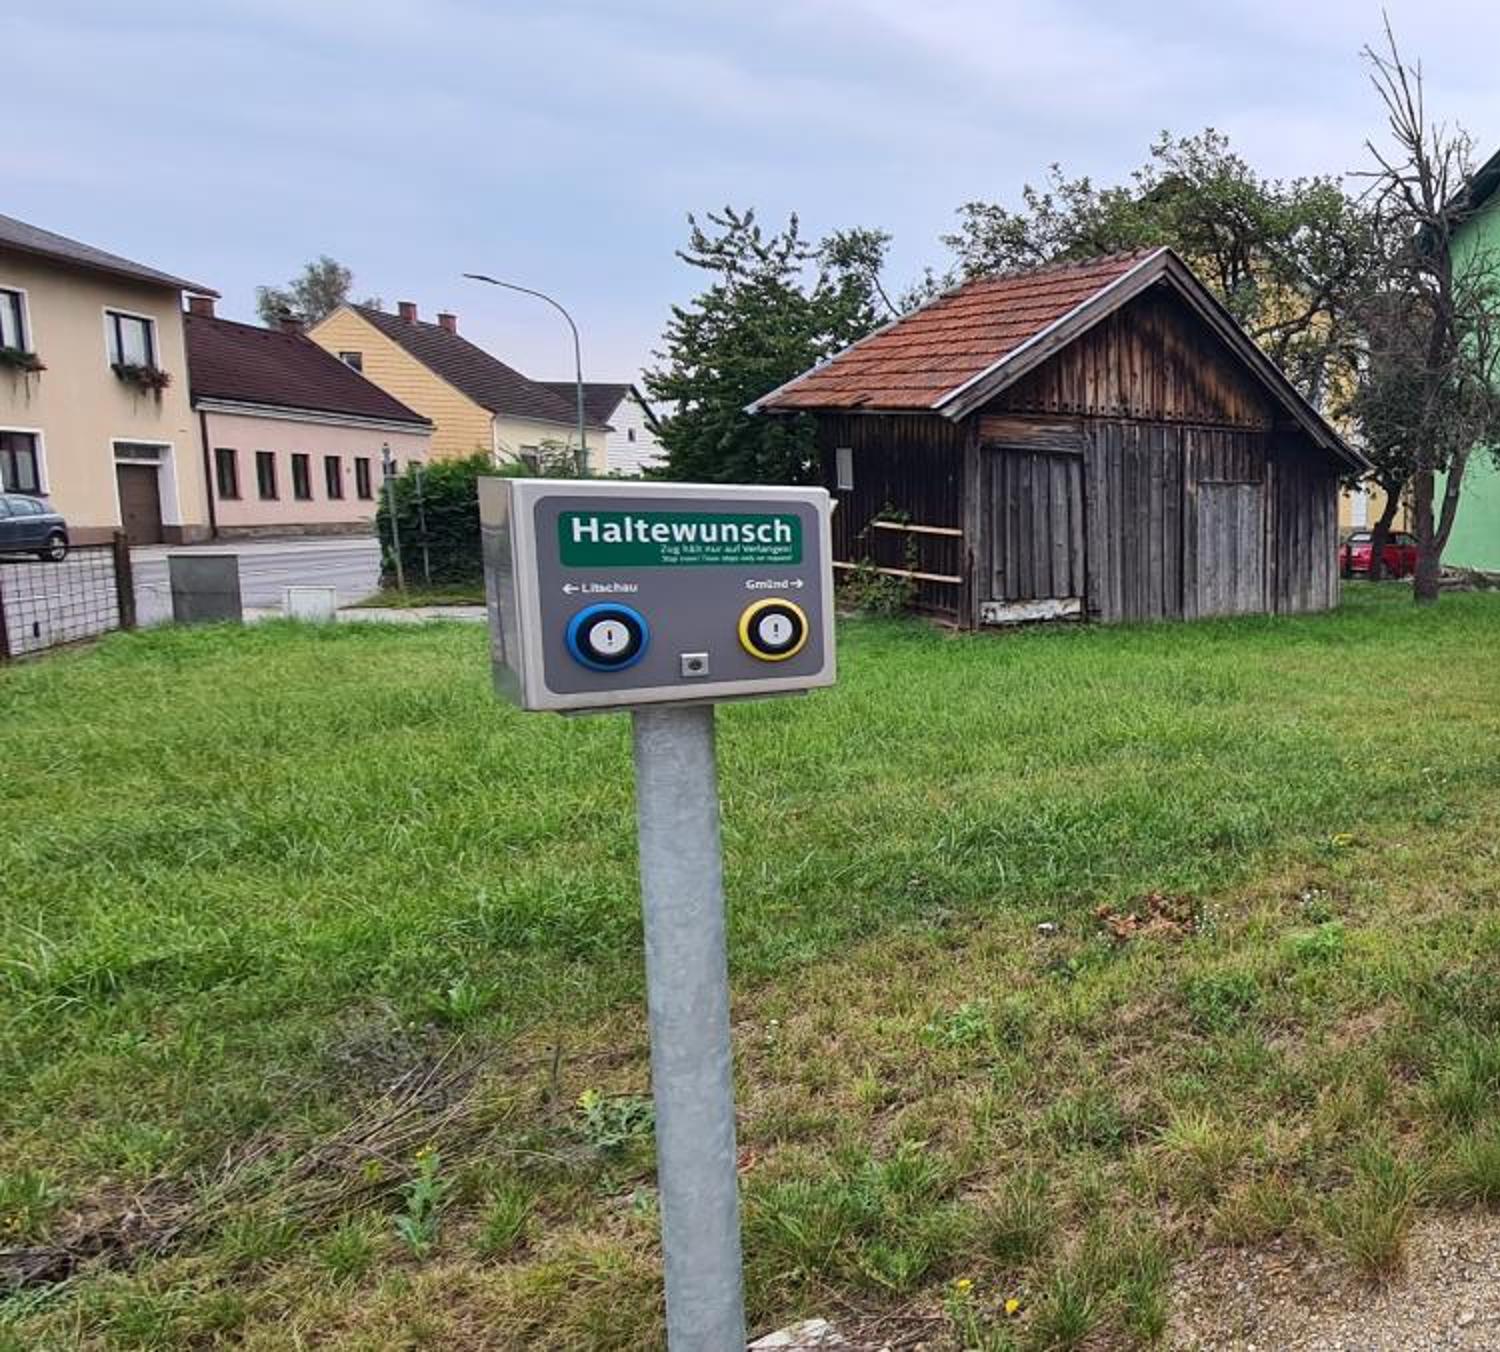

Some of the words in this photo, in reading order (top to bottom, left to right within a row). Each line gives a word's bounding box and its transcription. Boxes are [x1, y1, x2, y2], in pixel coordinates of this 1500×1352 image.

[571, 516, 792, 544] Haltewunsch
[660, 545, 681, 555] Zug
[724, 544, 740, 553] auf
[581, 582, 639, 594] Litschau
[745, 578, 789, 590] Gmünd
